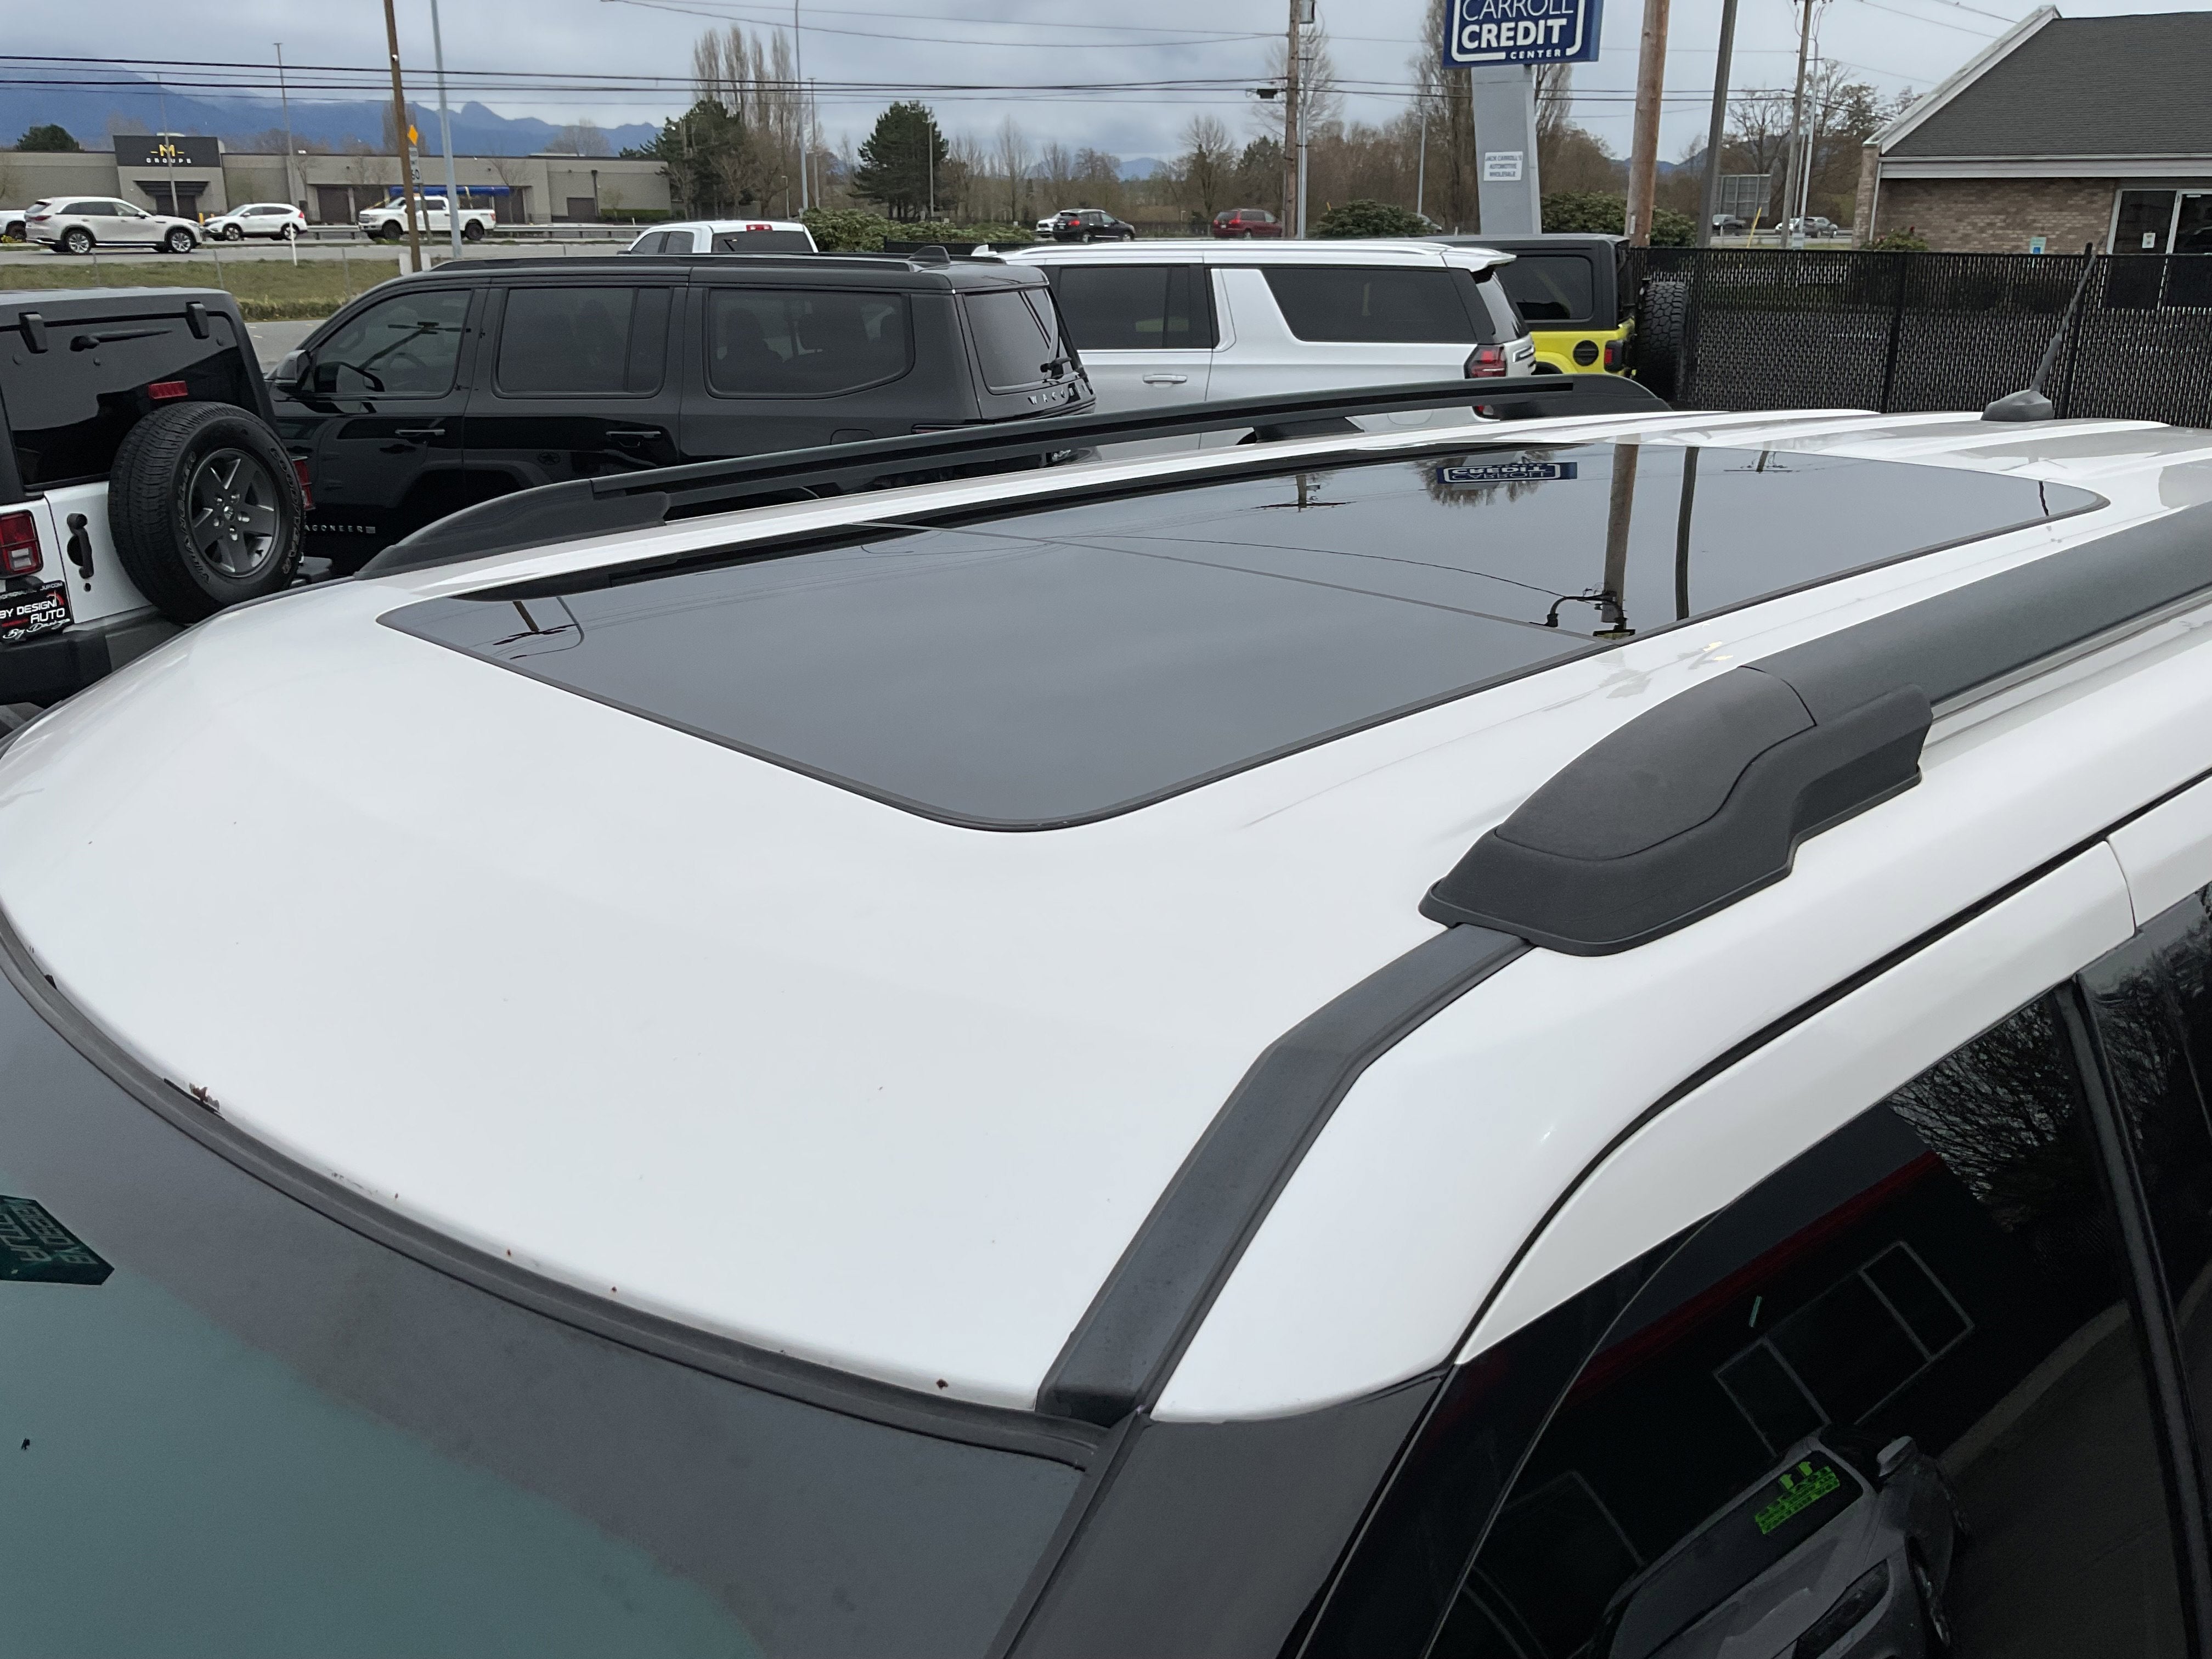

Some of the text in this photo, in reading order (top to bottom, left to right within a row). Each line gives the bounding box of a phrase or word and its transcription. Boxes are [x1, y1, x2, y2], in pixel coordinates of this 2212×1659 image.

[1463, 0, 1574, 21] CARROLL
[1461, 18, 1567, 49] CREDIT
[1510, 49, 1561, 59] CENTER
[1028, 383, 1087, 404] WAGON
[304, 524, 363, 533] AGONEER
[16, 599, 57, 616] DESIGN
[30, 607, 65, 624] AUTO
